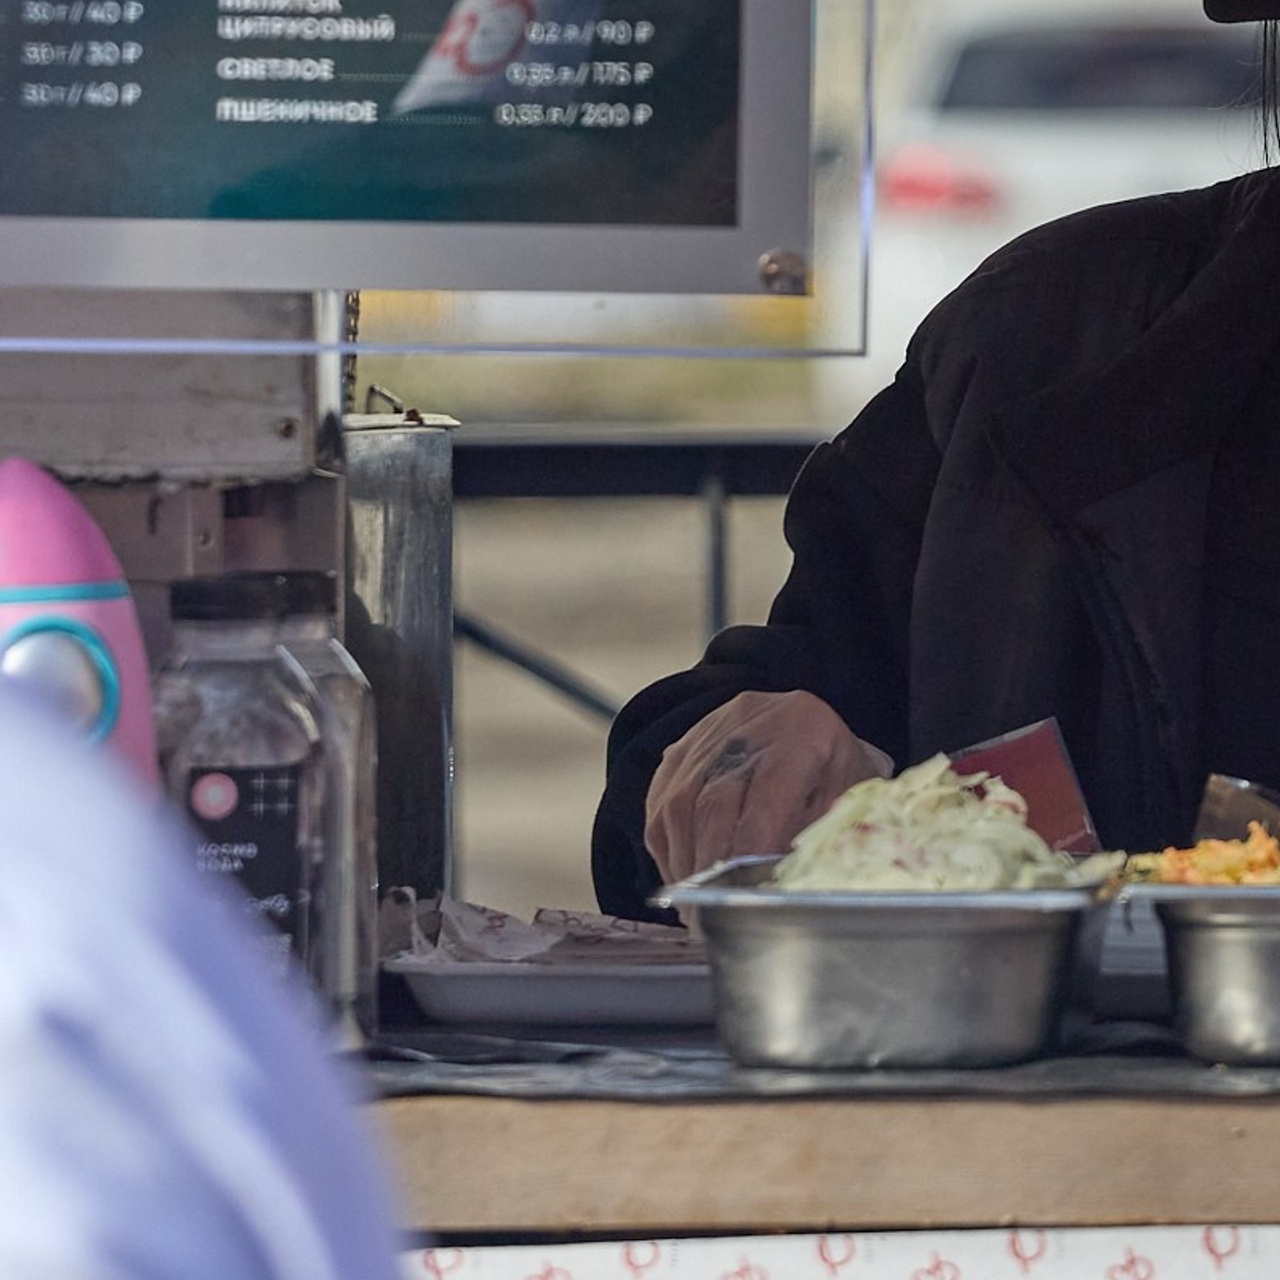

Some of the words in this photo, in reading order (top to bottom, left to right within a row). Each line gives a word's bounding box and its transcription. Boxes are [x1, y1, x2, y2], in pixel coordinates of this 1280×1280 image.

[217, 14, 395, 41] ЦИТРУСОВЫЙ
[216, 58, 335, 81] СВЕТЛОЕ
[216, 98, 379, 123] ПШЕНИЧНОЕ
